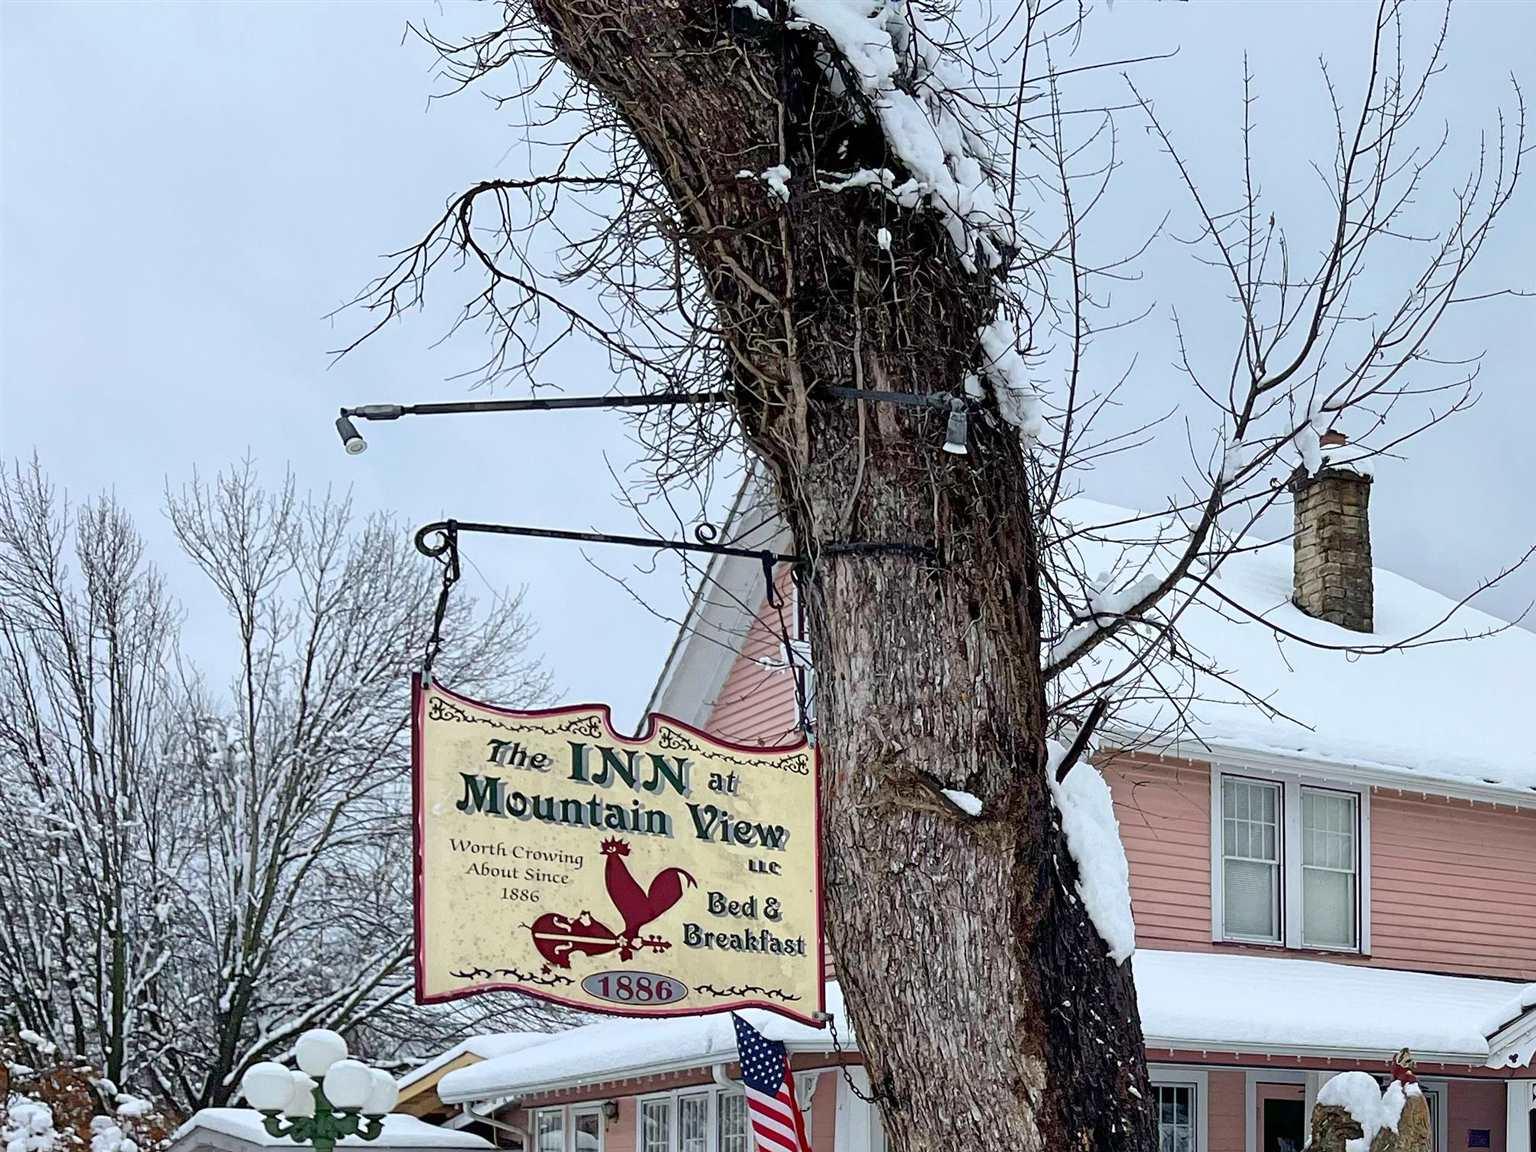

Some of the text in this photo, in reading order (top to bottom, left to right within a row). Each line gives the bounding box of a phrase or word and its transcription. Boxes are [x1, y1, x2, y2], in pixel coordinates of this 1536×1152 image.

[486, 738, 738, 796] The INN at
[456, 772, 790, 850] Mountain View
[449, 837, 584, 869] Worth Crowing
[748, 858, 782, 876] LLC
[465, 861, 569, 885] About Since
[500, 887, 541, 903] 1886
[706, 891, 782, 921] Bed &
[682, 923, 807, 957] Breakfast
[598, 975, 675, 1002] 1886
